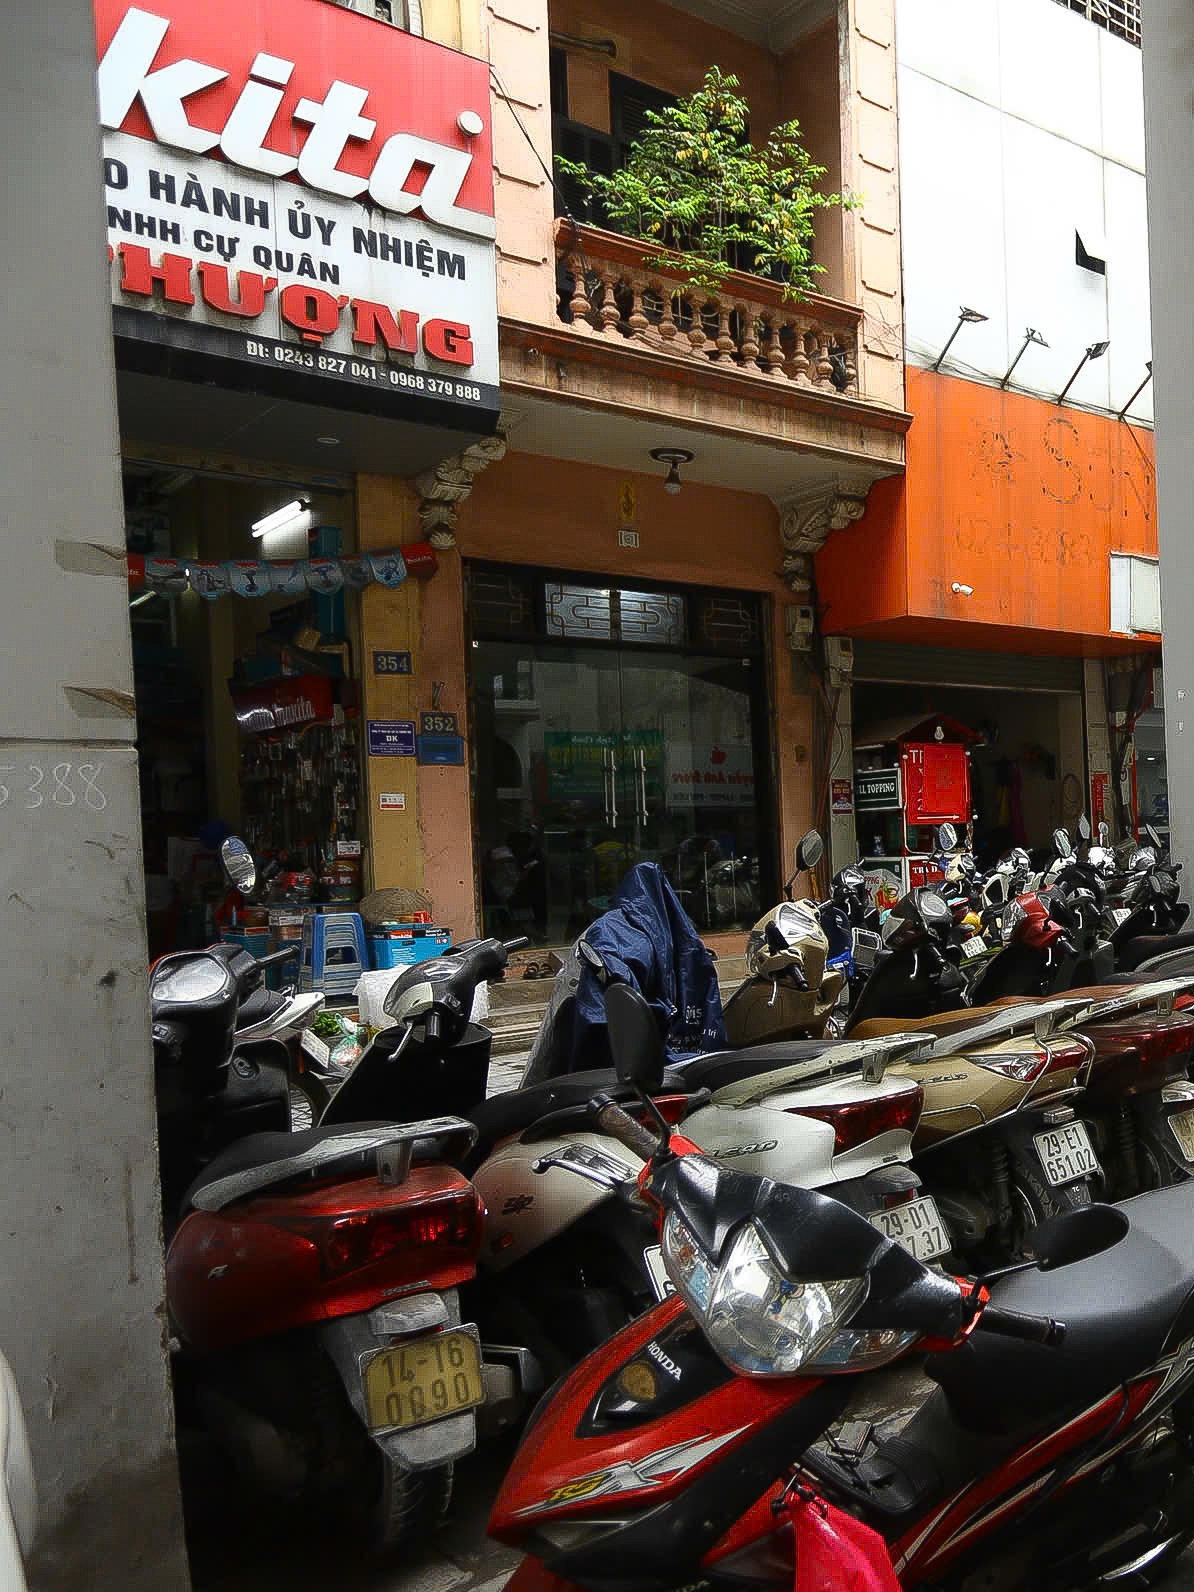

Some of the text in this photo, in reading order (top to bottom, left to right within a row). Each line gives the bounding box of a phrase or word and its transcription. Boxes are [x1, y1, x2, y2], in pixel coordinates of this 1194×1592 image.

[104, 158, 466, 281] O HÀNH ỦY NHIỆM
[107, 205, 340, 285] NHH CỰ QUÂN
[107, 241, 475, 366] HƯỢNG
[274, 346, 314, 369] 0243
[317, 355, 347, 375] 827
[351, 361, 377, 381] 041
[389, 370, 425, 390] 0968
[428, 378, 454, 397] 379
[455, 382, 481, 401] 888
[377, 655, 409, 672] 354
[424, 715, 455, 733] 352
[867, 782, 896, 794] TOPPING
[1043, 1126, 1082, 1158] 29-E1
[1046, 1148, 1096, 1182] 651.02
[880, 1203, 931, 1238] 29-D1
[898, 1226, 942, 1259] 7.37
[647, 1340, 682, 1381] HONDA
